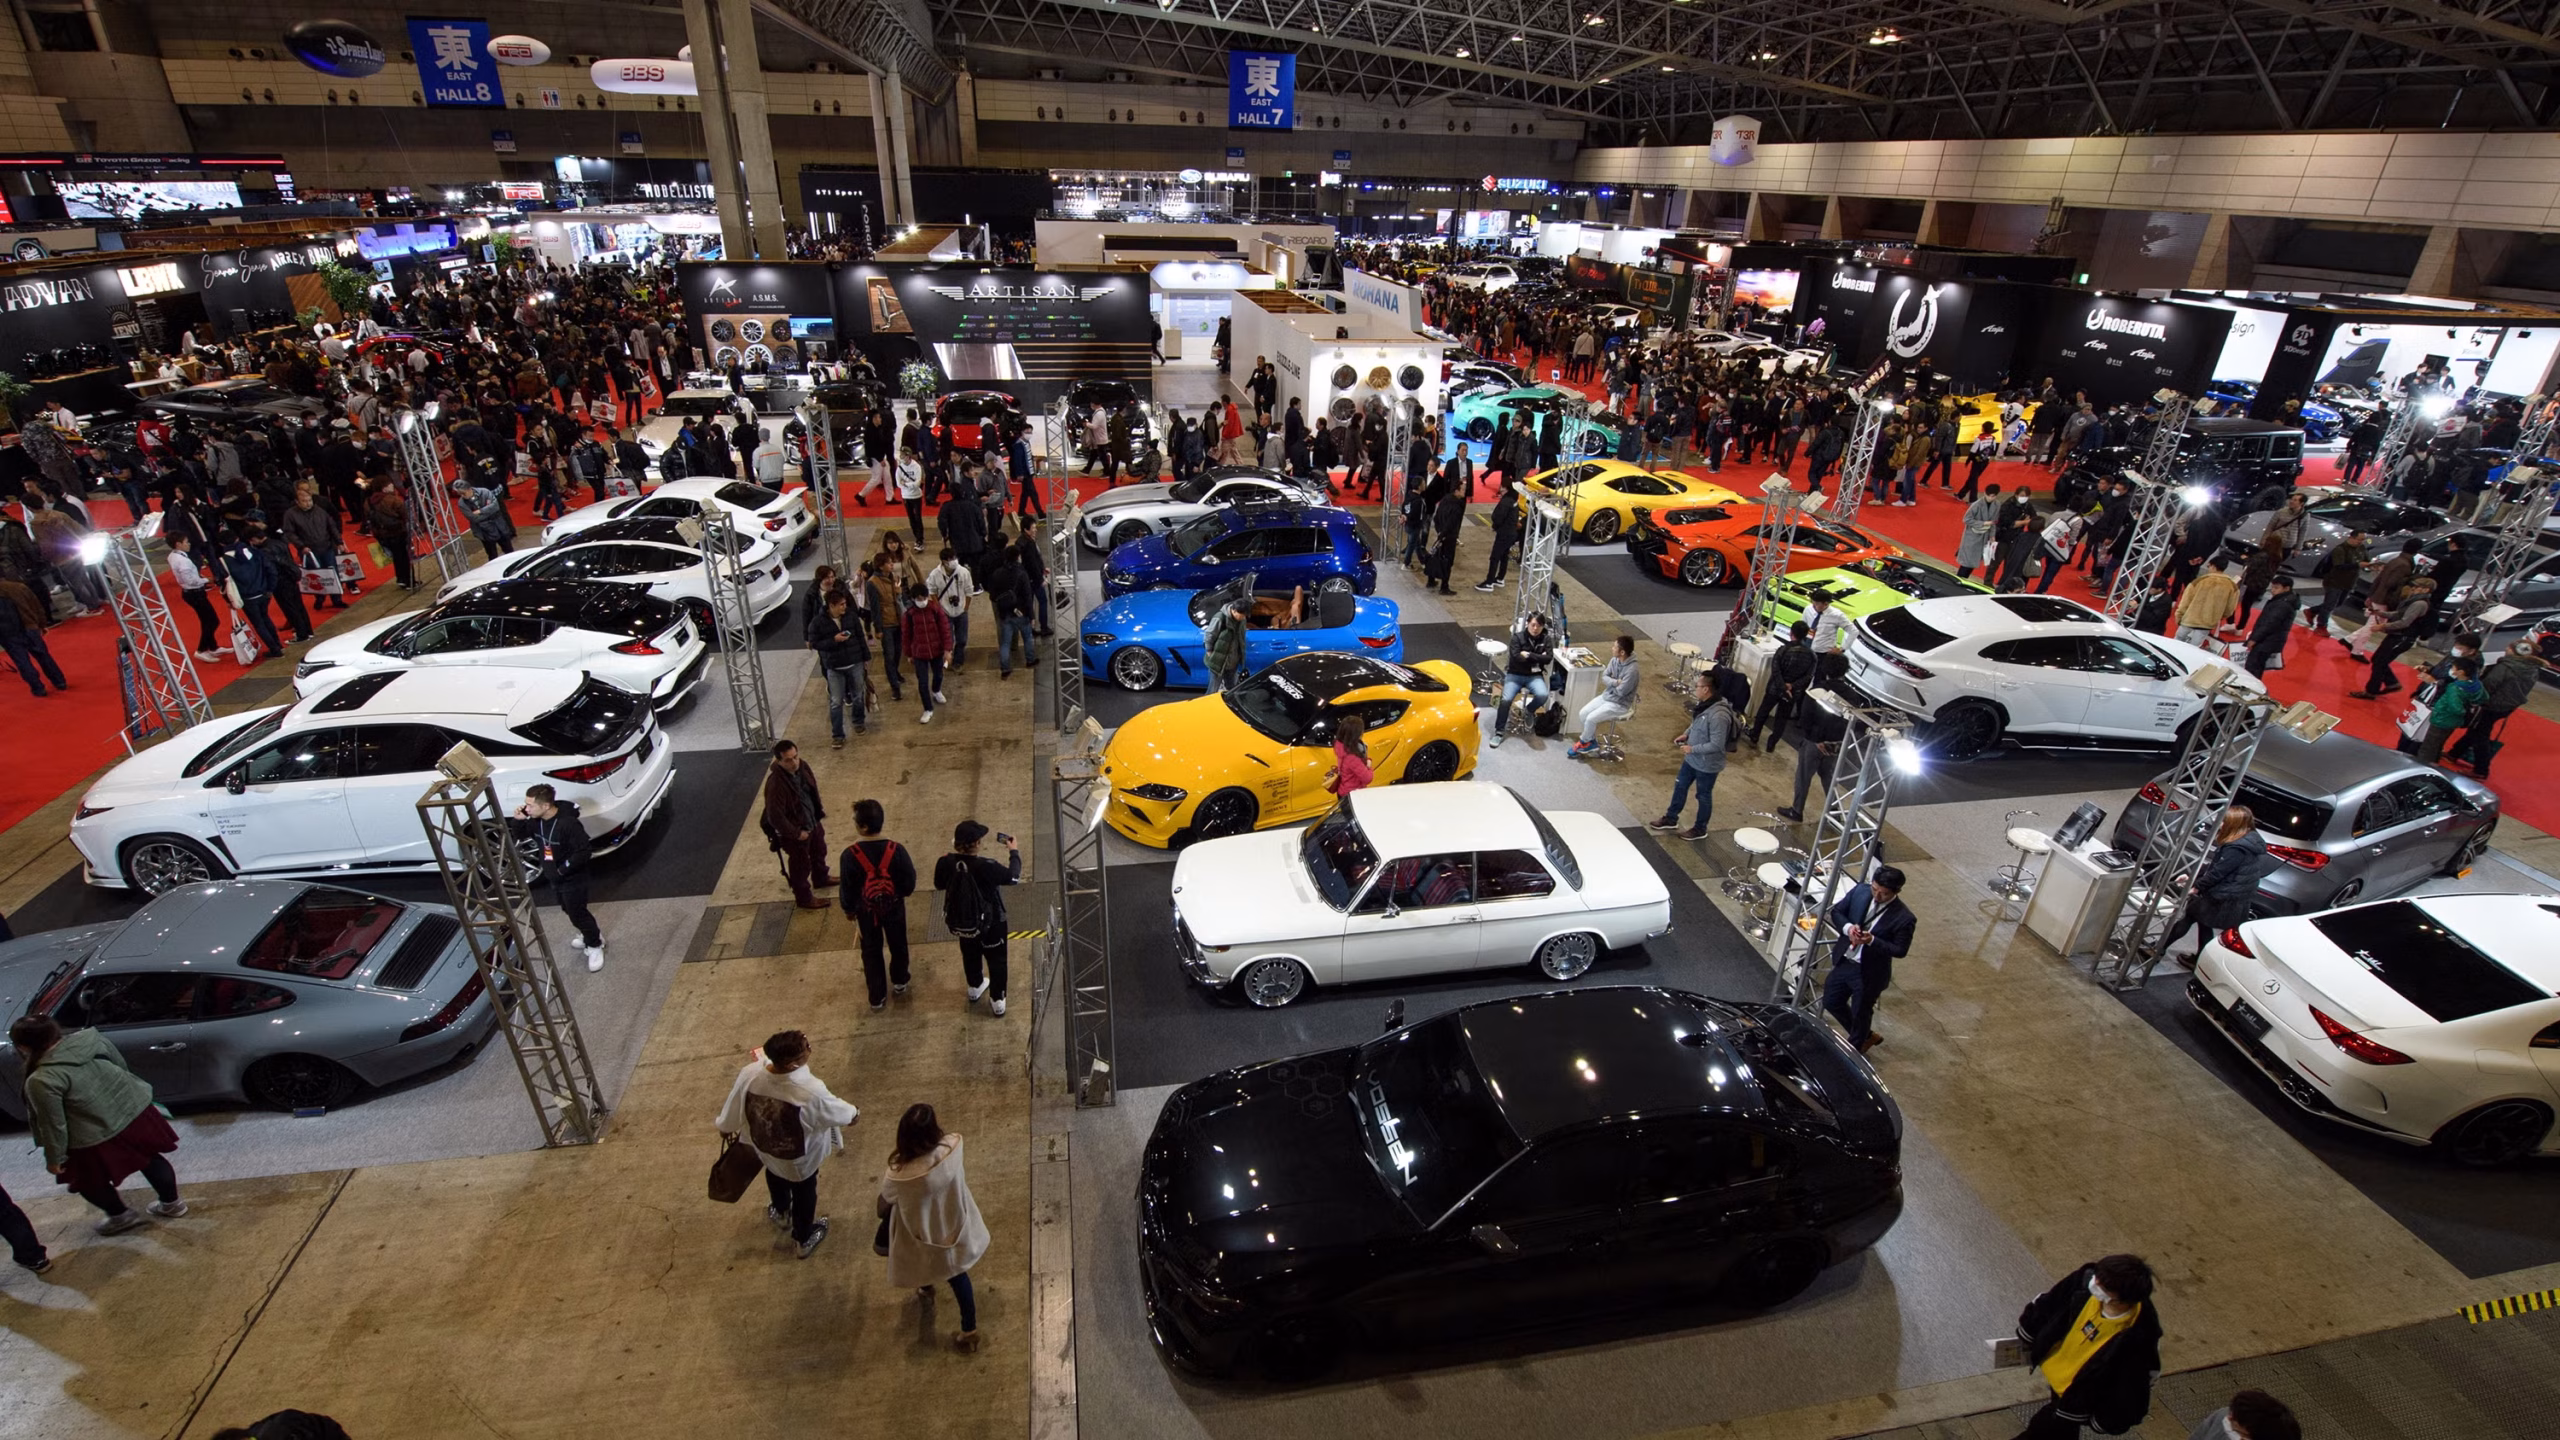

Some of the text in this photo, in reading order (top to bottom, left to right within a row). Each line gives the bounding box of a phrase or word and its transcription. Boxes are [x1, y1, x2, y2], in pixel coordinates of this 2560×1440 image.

[427, 25, 478, 70] 東
[498, 46, 532, 58] TRD
[447, 72, 472, 81] EAST
[621, 65, 664, 82] BBS
[1245, 57, 1280, 97] 東
[436, 83, 492, 101] HALL 8
[1250, 98, 1273, 107] EAST
[1238, 109, 1284, 125] HALL 7
[1204, 172, 1250, 182] SUBARU
[1498, 177, 1548, 190] SUZUKI
[200, 183, 237, 192] YARIS
[506, 188, 542, 199] TRD
[835, 189, 863, 197] Sport
[1287, 236, 1327, 246] RECARO
[270, 252, 305, 271] AIRREX
[307, 246, 338, 267] BRIDE
[4, 278, 94, 311] ADVAN
[969, 284, 1076, 297] ARTISAN
[1352, 280, 1399, 315] ROHANA
[2103, 316, 2165, 340] ROBERUTA
[1367, 1068, 1418, 1187] VOSSEN
